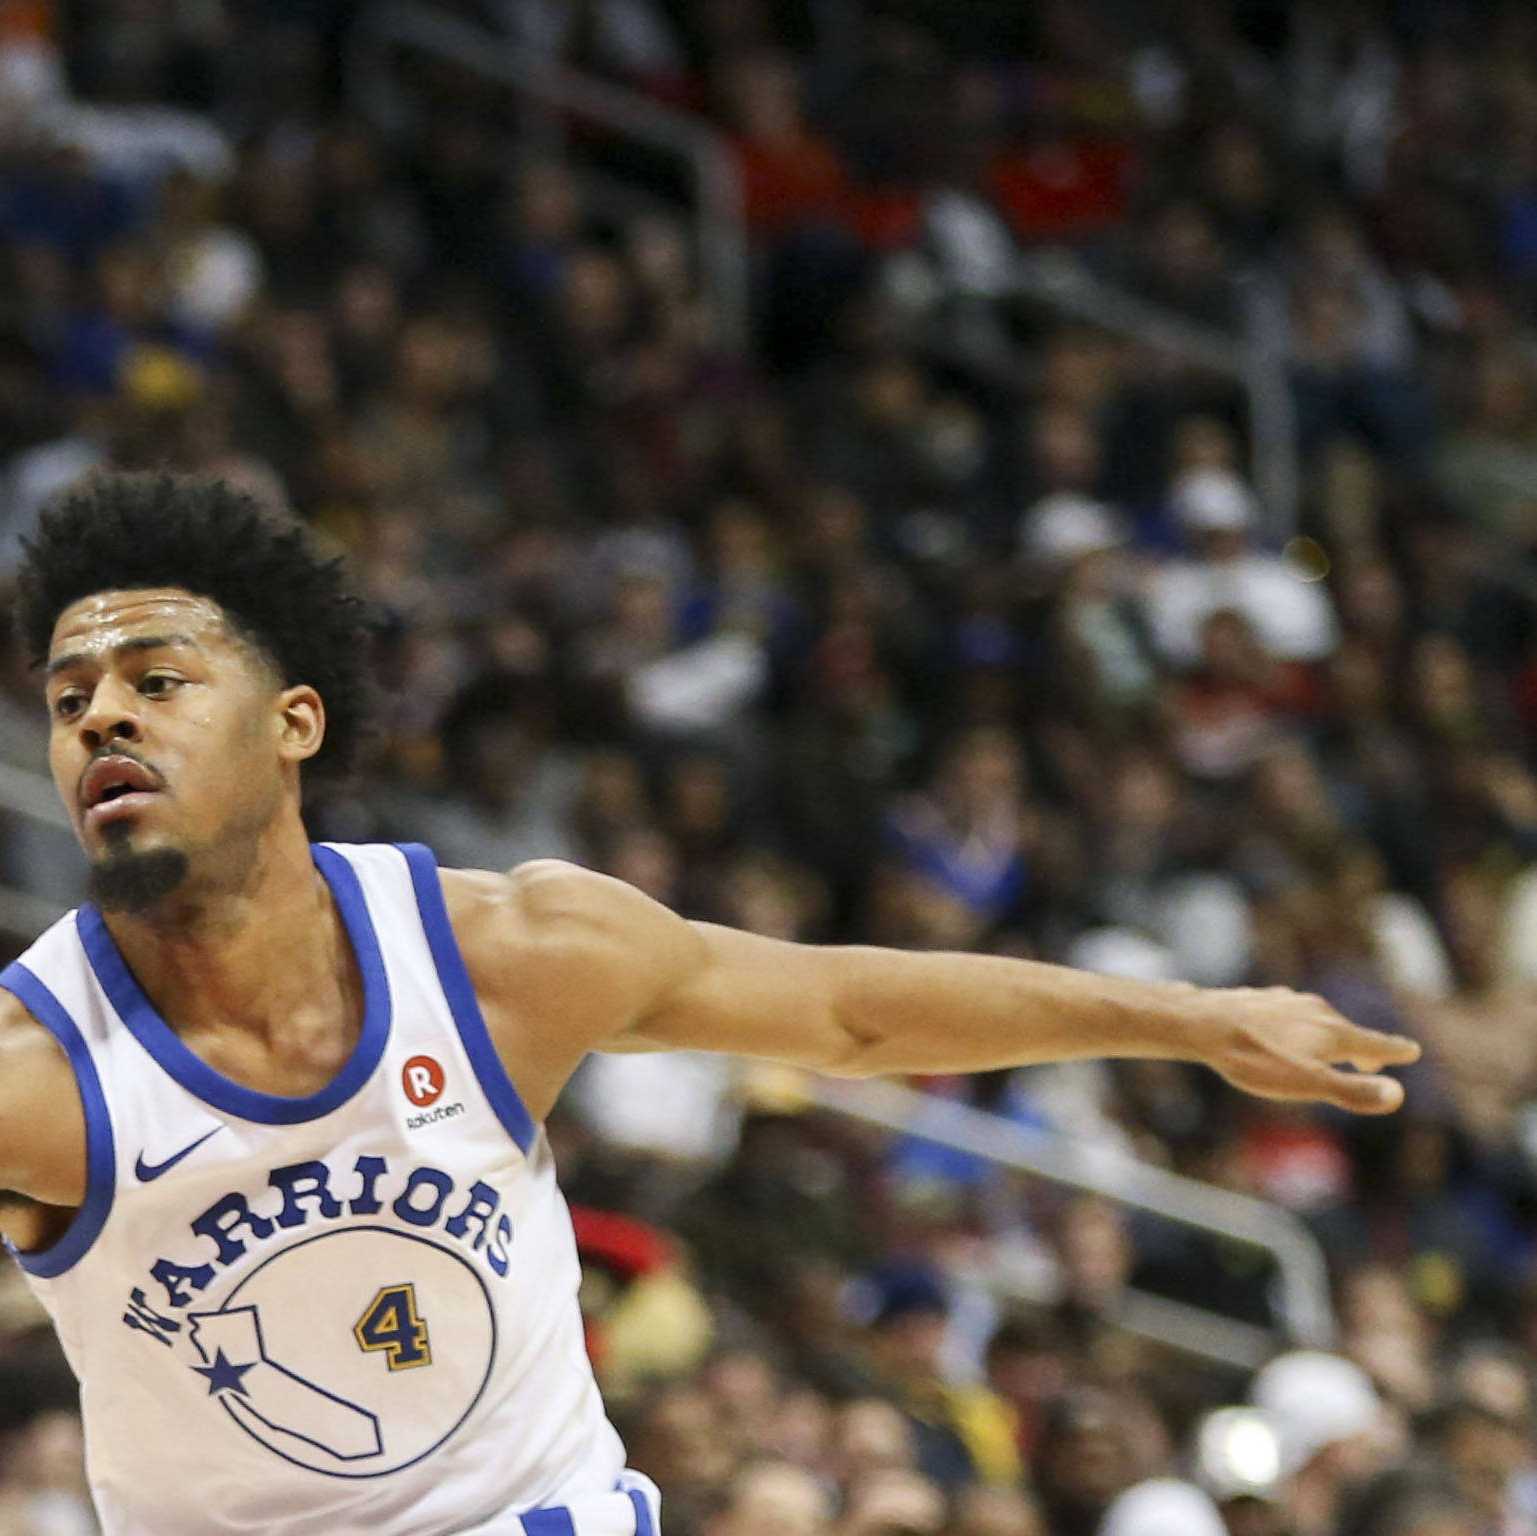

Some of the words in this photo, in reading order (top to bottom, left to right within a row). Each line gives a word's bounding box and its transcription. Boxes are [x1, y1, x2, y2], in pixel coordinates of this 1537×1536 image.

[407, 1102, 465, 1131] Rakuten
[123, 1155, 513, 1347] WARRIORS
[353, 1283, 432, 1372] 4
